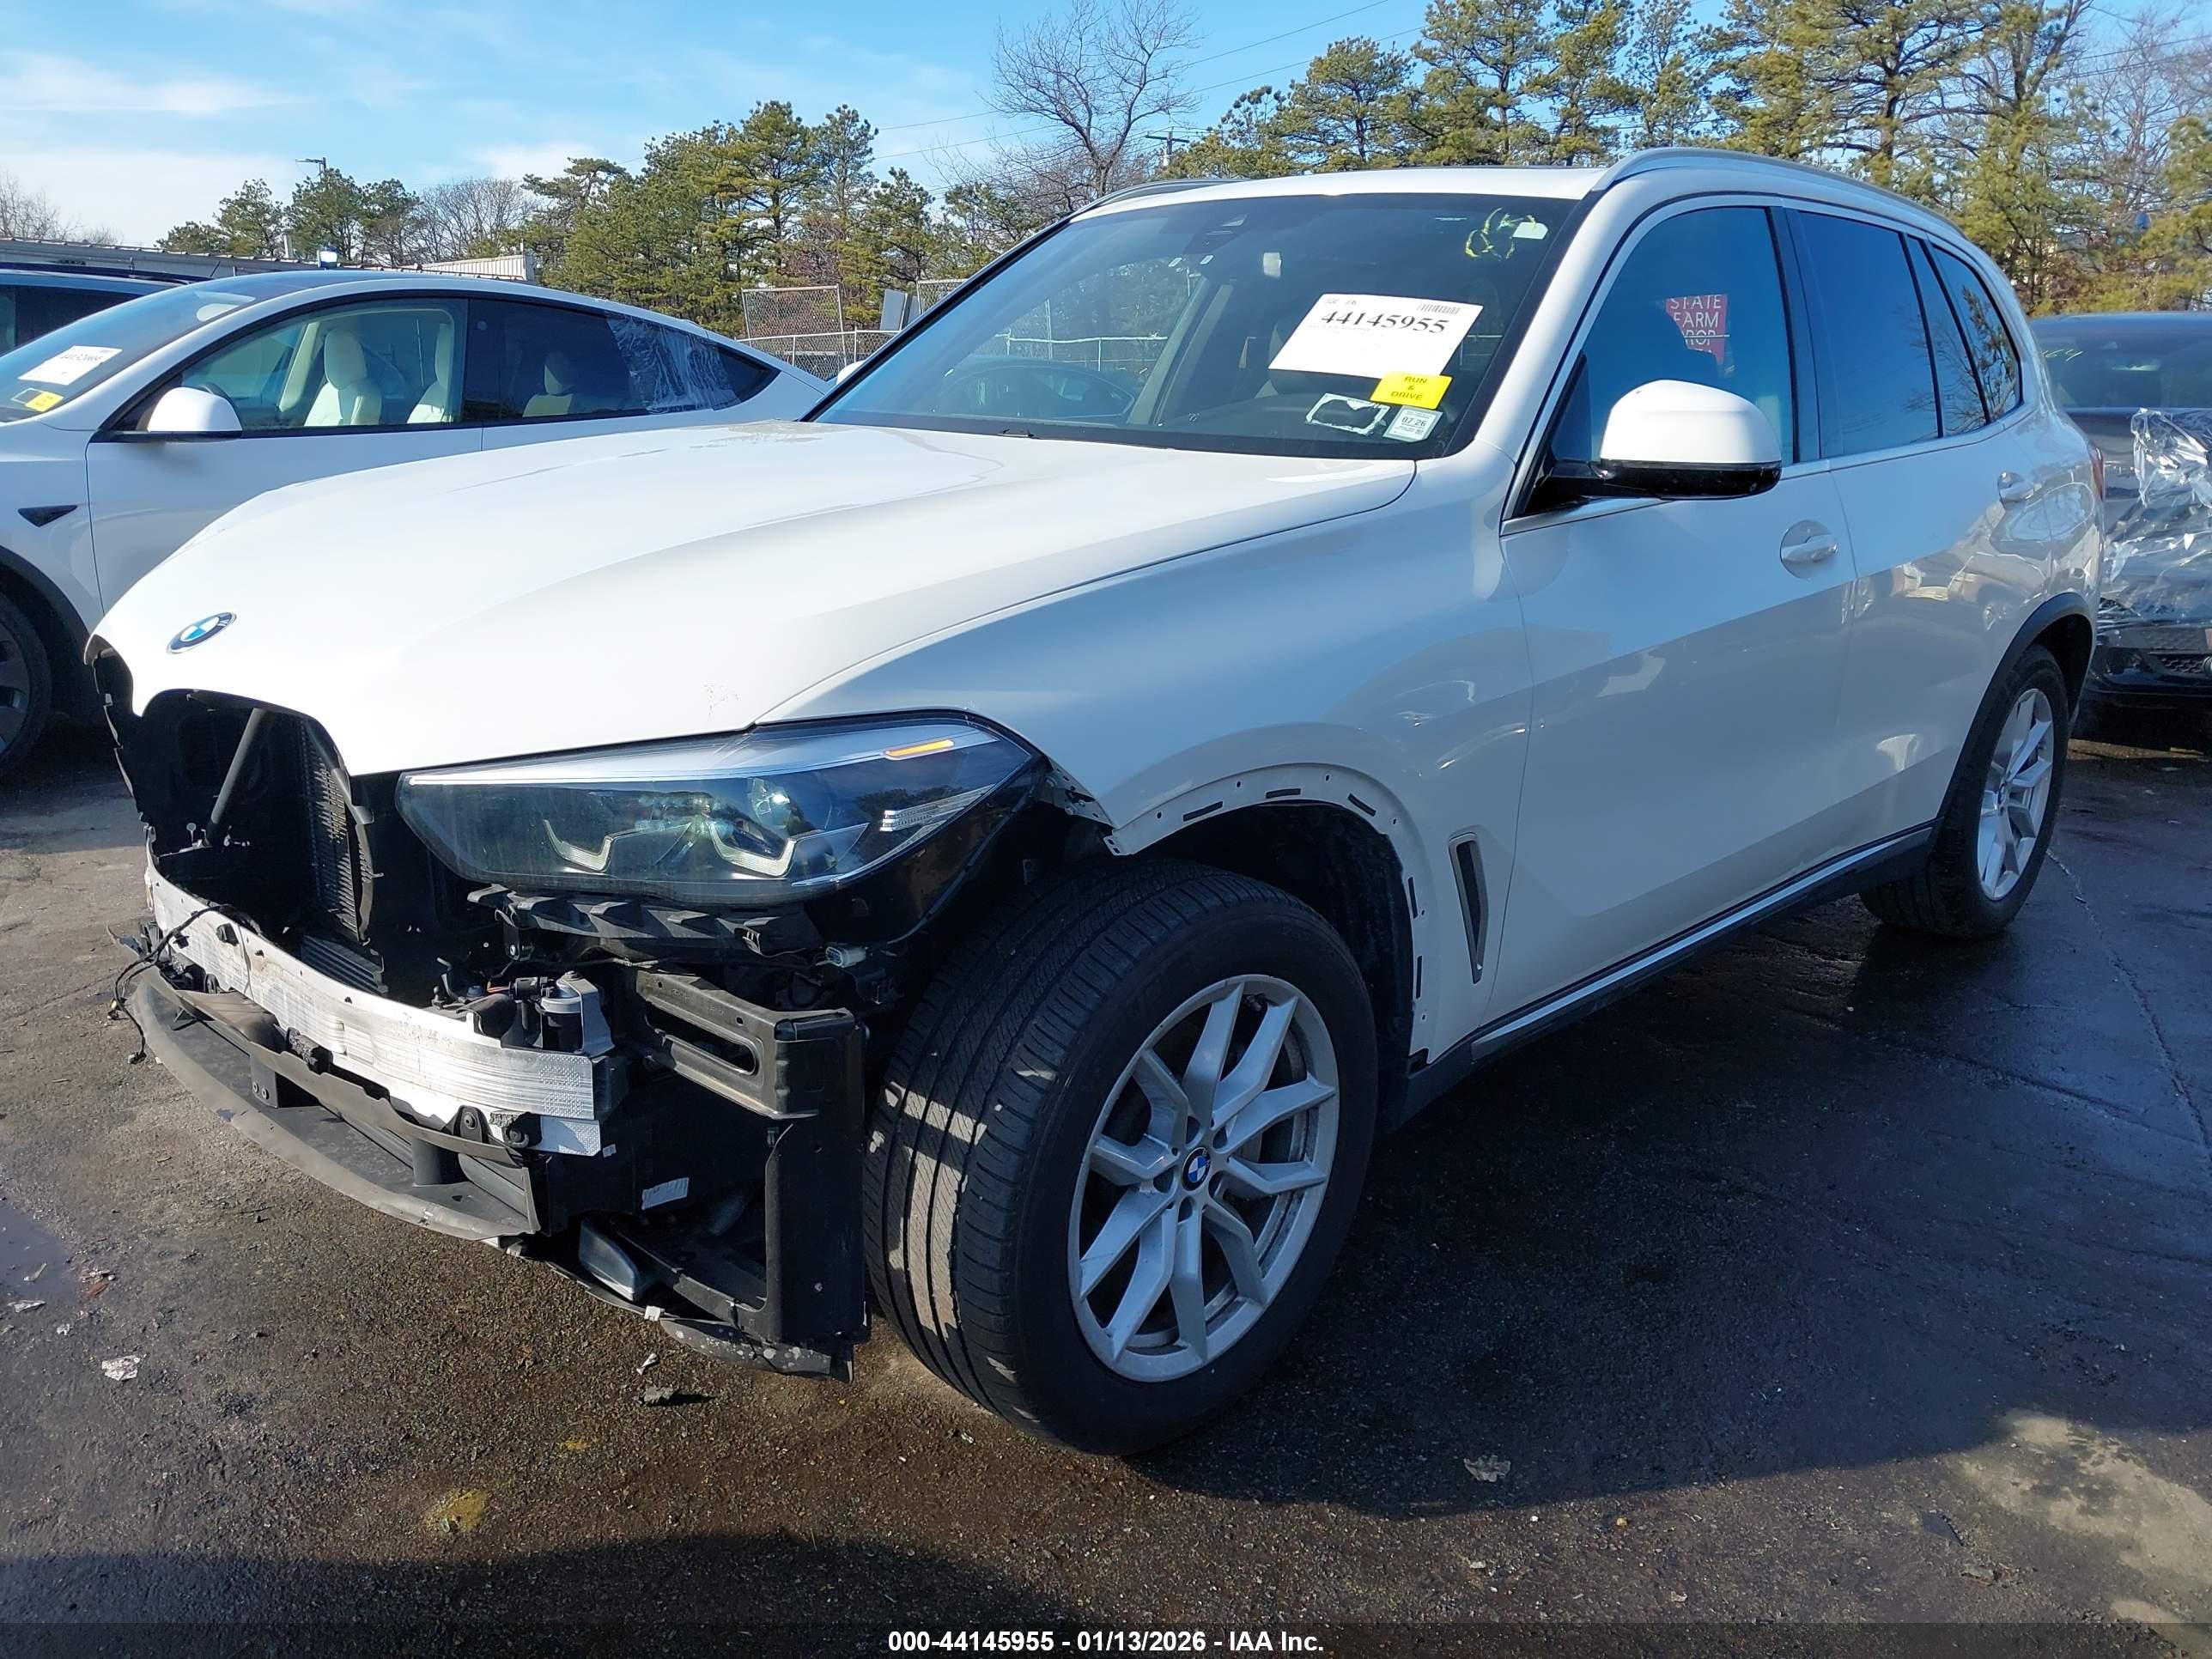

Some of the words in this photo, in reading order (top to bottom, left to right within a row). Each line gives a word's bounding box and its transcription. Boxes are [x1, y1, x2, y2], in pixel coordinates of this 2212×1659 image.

[1670, 295, 1722, 310] STATE
[1321, 311, 1450, 334] 44145955
[1673, 312, 1719, 328] FARM
[1391, 391, 1424, 401] DRIVE
